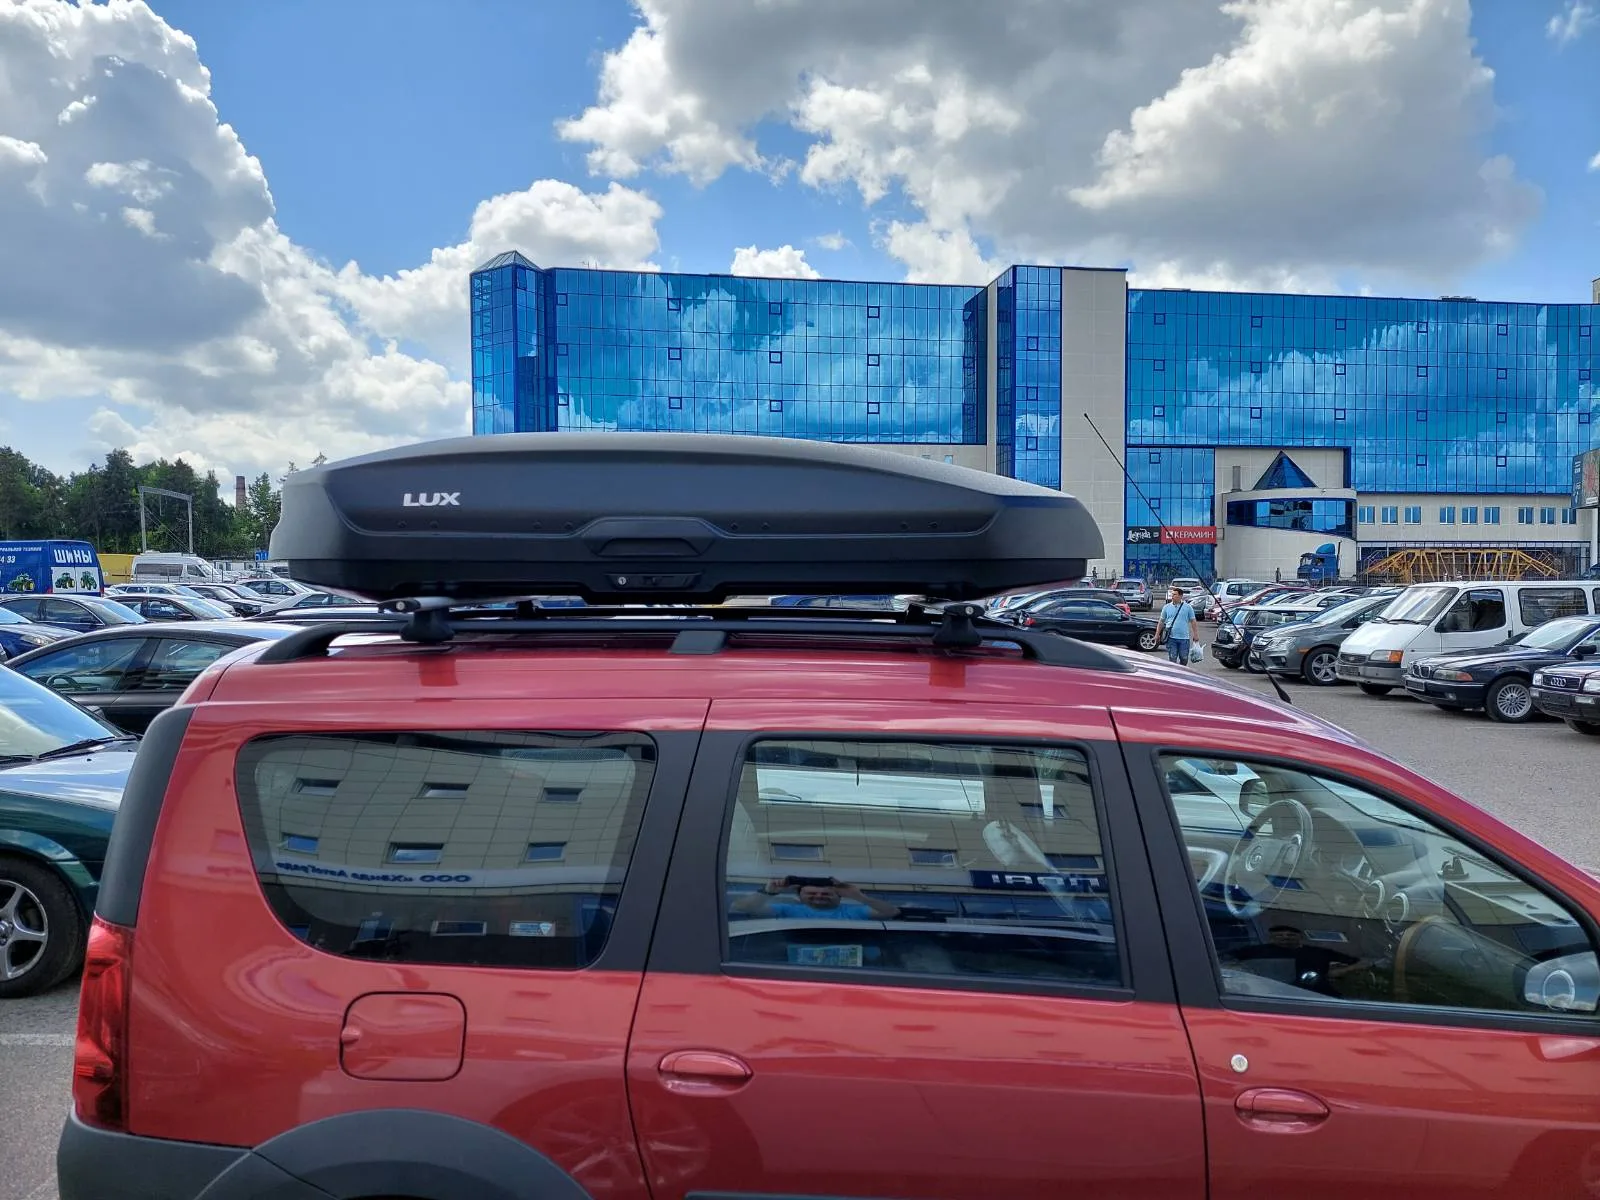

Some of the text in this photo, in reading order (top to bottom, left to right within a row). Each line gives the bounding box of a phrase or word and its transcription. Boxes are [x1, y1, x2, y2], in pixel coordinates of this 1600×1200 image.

[403, 492, 461, 507] LUX
[1174, 530, 1214, 539] КЕРАМИН
[53, 549, 93, 564] ШИНЫ
